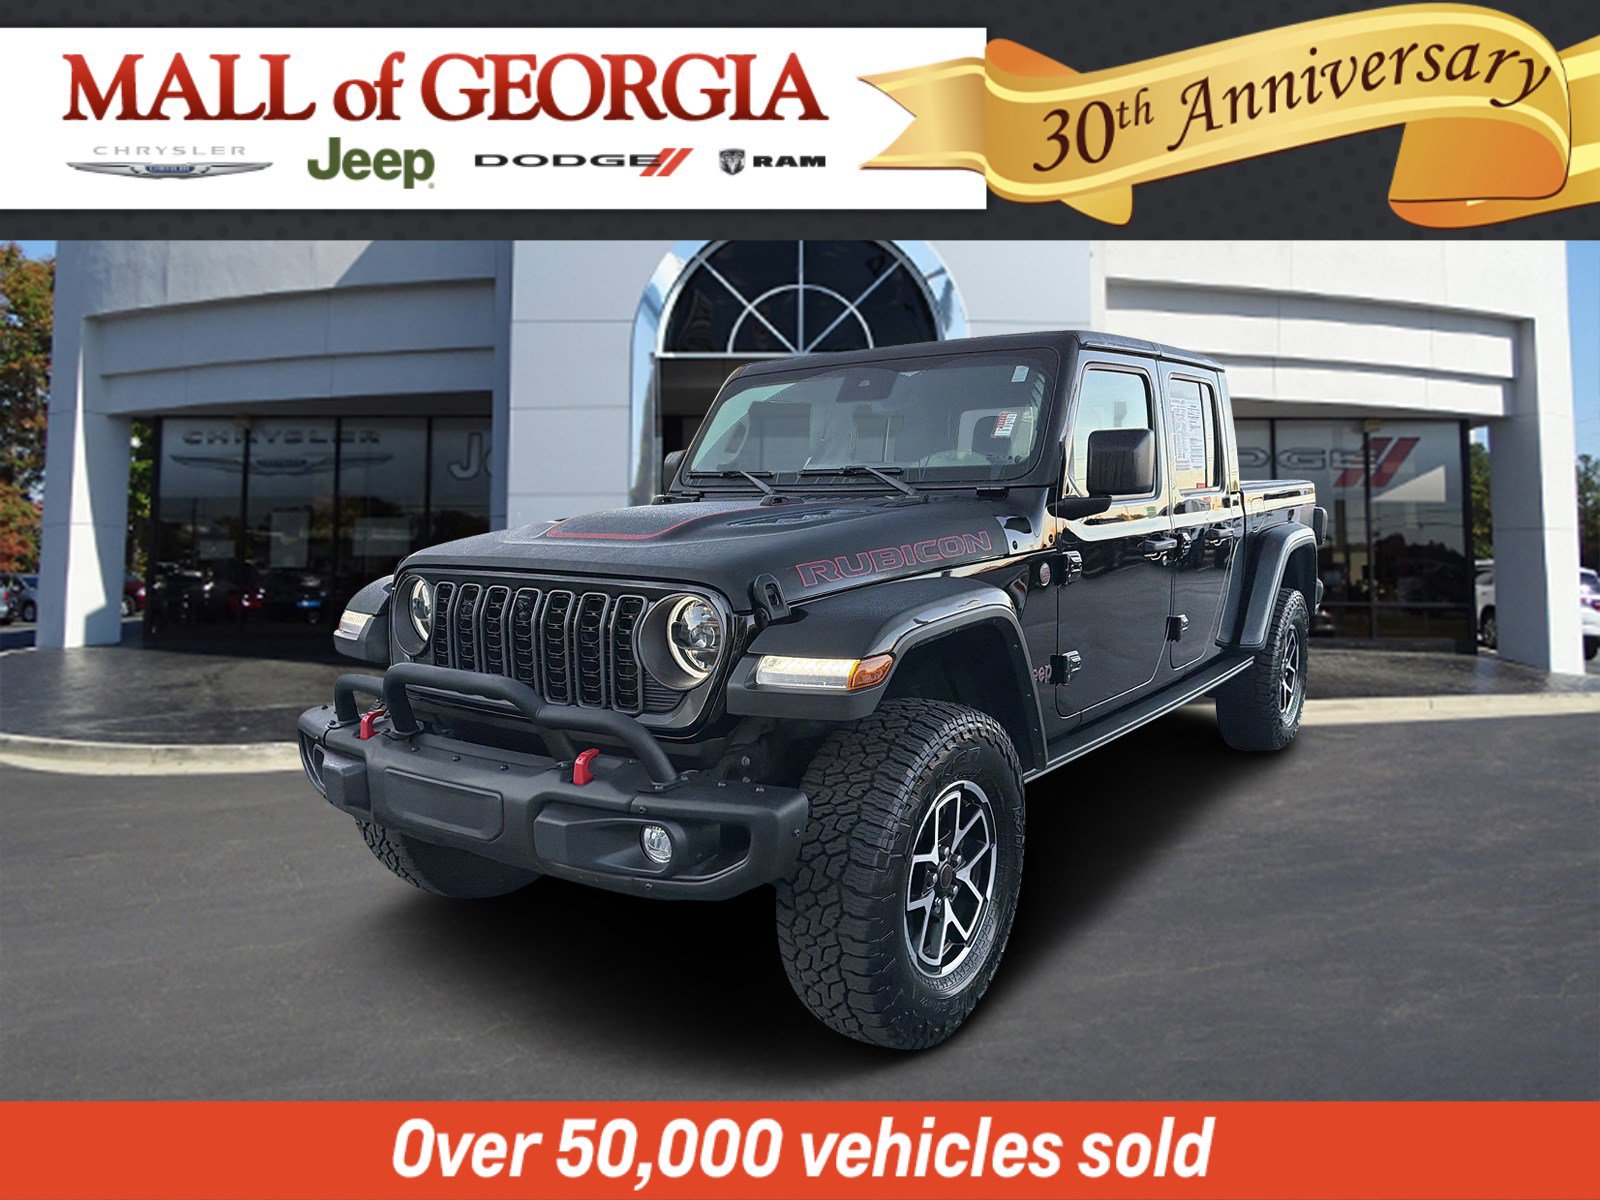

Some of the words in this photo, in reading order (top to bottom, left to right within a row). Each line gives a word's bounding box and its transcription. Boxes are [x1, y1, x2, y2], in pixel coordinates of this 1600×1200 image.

[182, 428, 381, 445] CHRYSLER
[795, 531, 992, 587] RUBICON
[1032, 664, 1053, 684] eep
